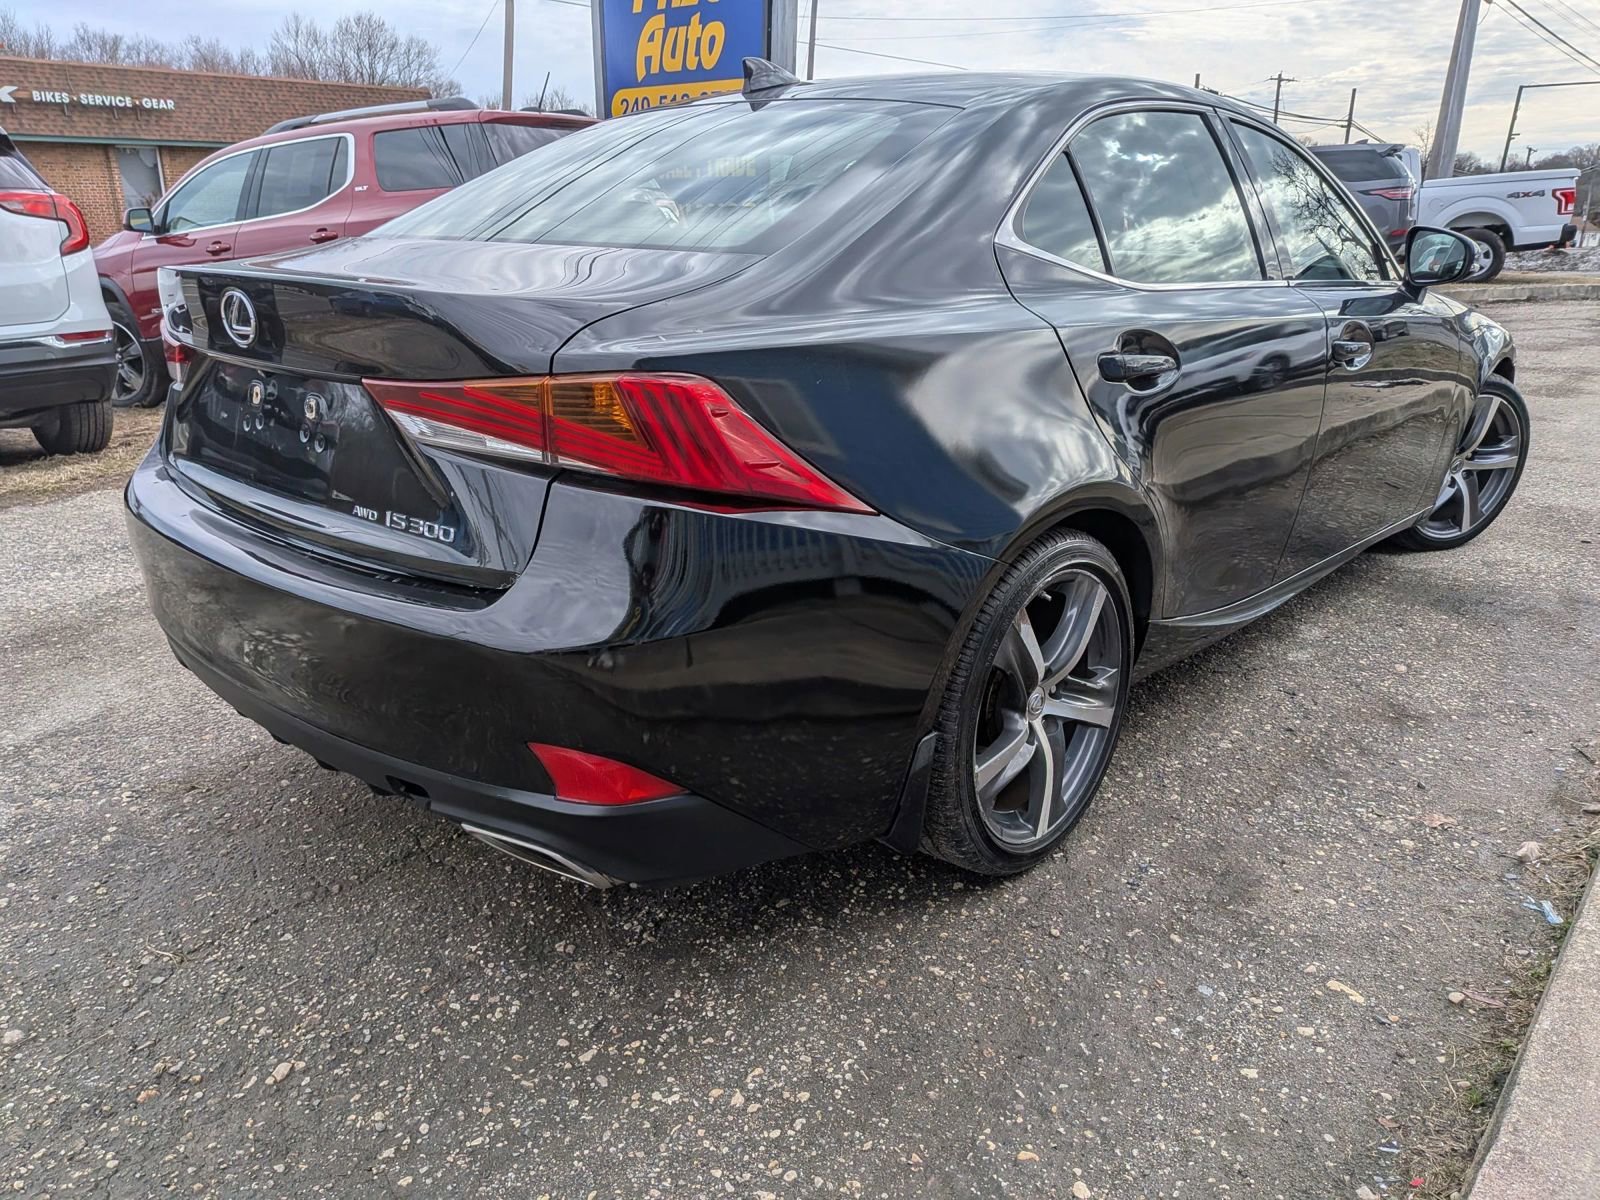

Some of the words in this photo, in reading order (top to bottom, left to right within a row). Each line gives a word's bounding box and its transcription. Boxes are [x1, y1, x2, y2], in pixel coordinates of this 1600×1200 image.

[636, 11, 725, 83] Auto
[32, 90, 70, 104] BIKES
[79, 93, 133, 108] SERVICE
[142, 97, 176, 110] GEAR
[352, 505, 378, 521] AWD
